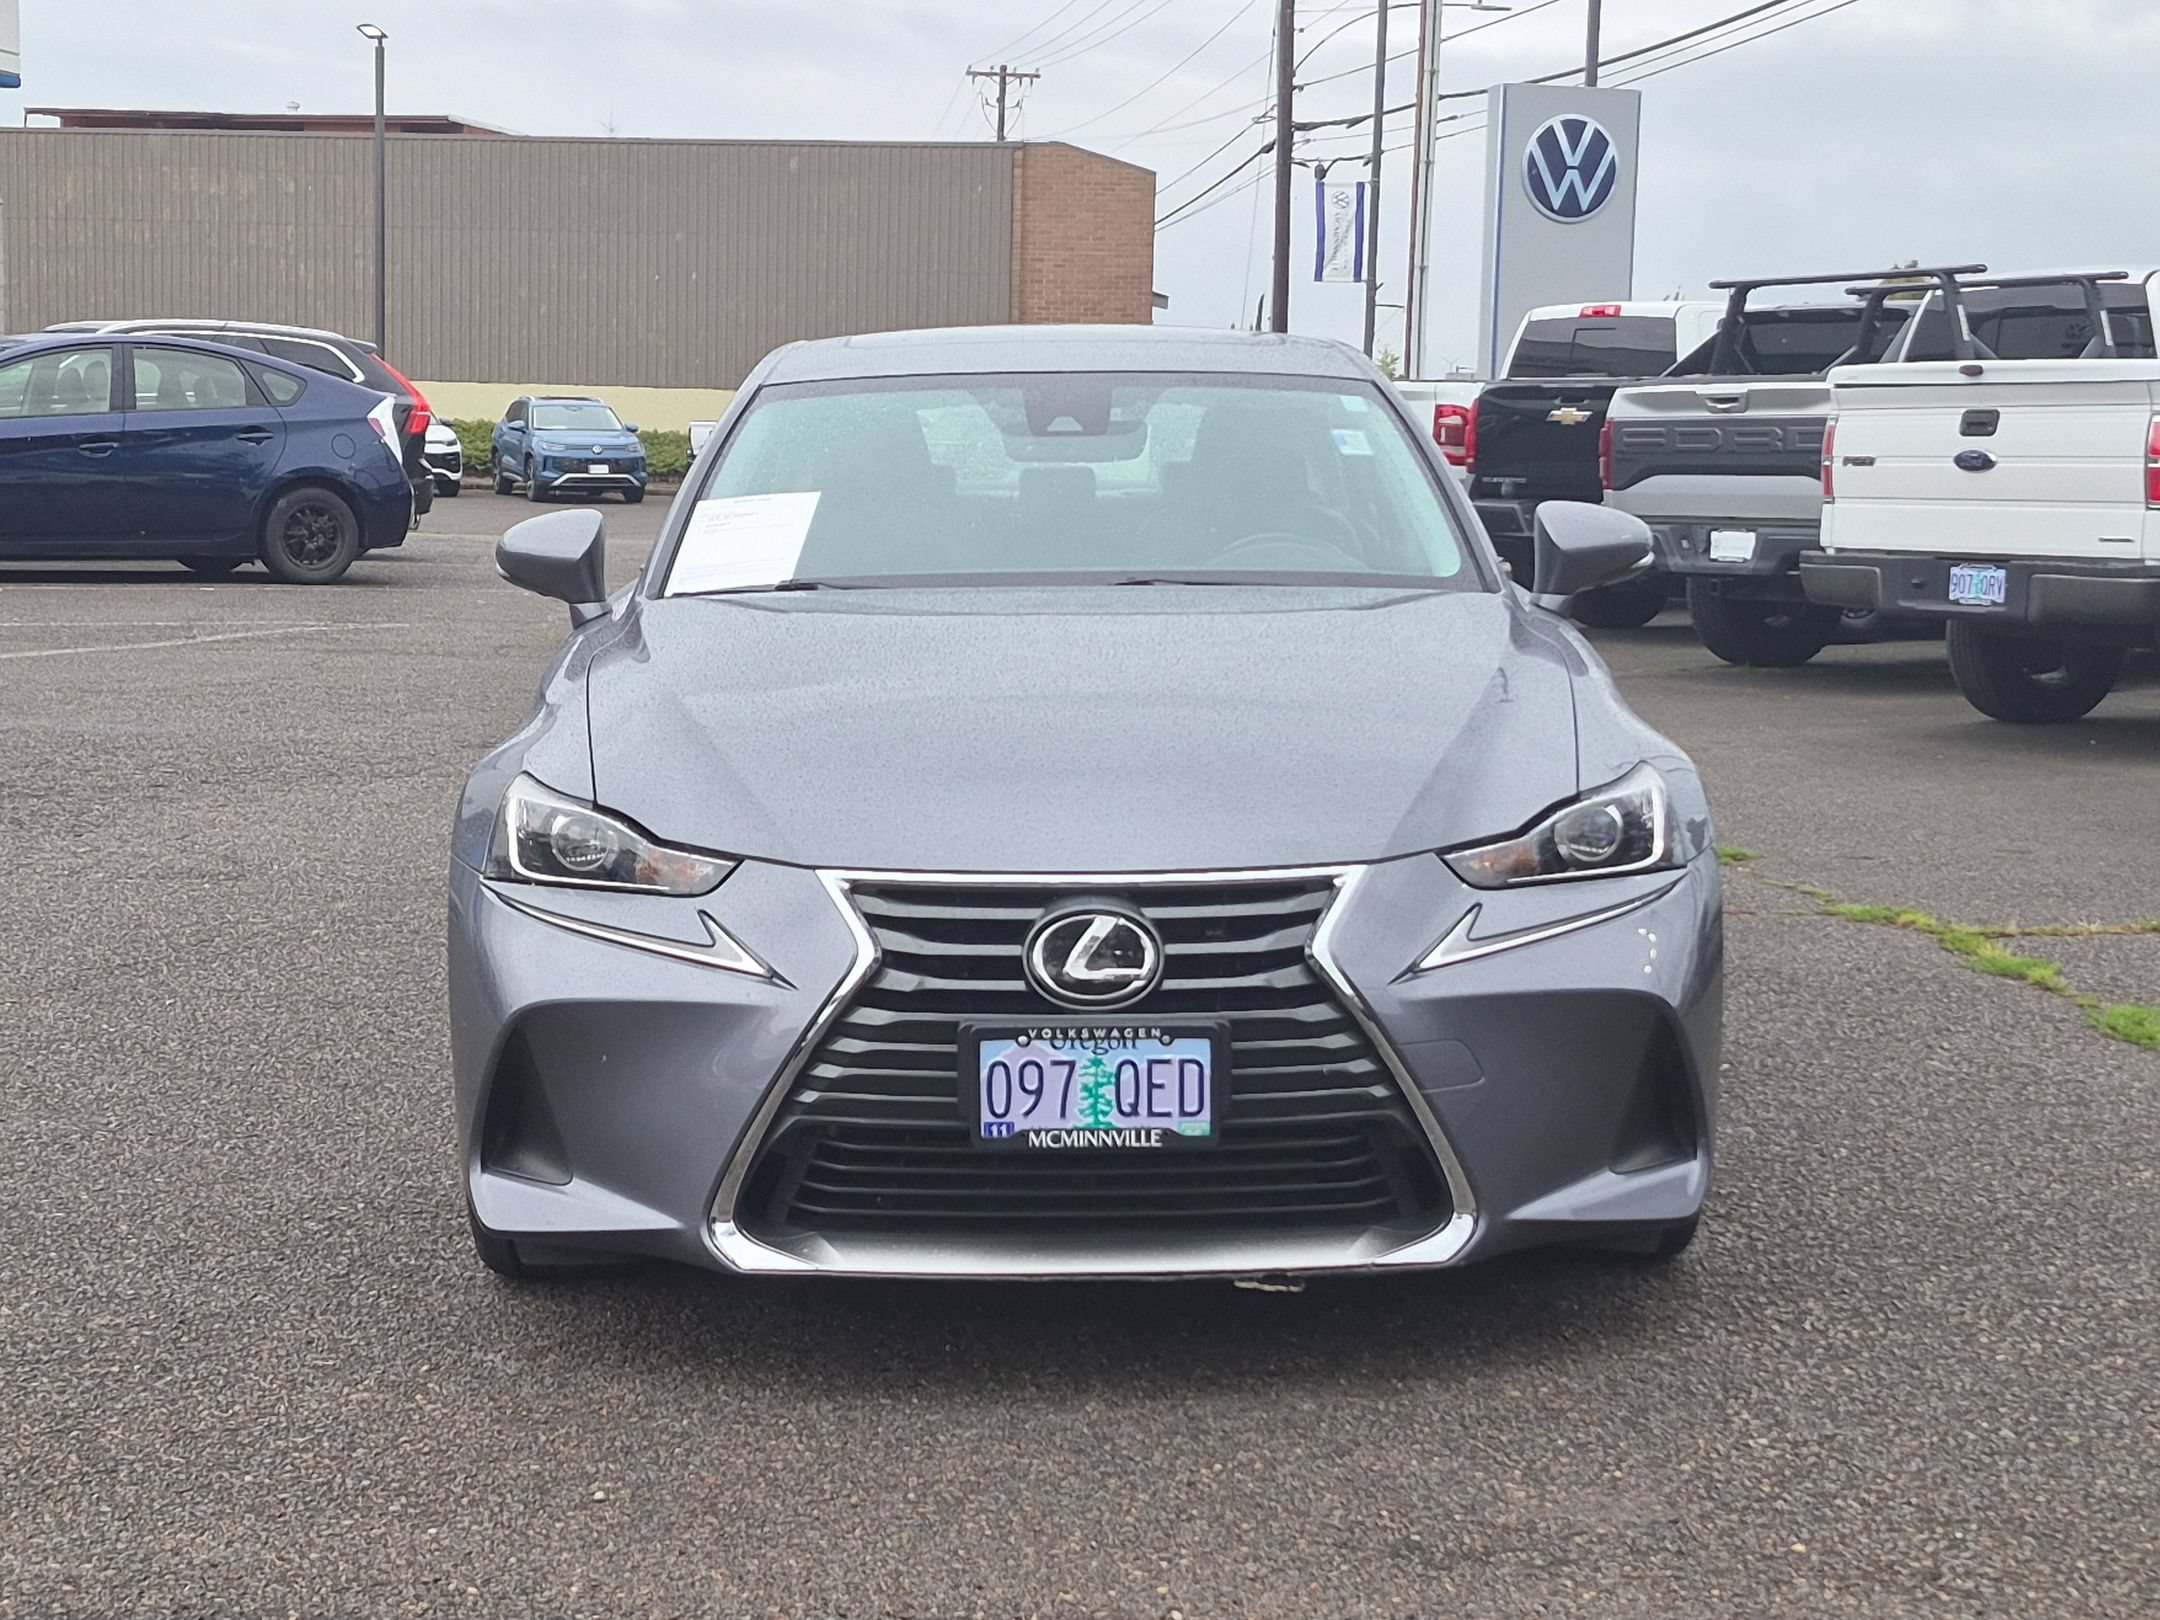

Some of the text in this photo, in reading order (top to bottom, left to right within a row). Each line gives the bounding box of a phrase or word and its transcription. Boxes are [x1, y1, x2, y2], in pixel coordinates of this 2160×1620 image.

[1526, 116, 1617, 221] VW
[1027, 1027, 1162, 1040] VOLKSWAGEN
[985, 1058, 1205, 1120] 097 QED
[1028, 1128, 1163, 1149] MCMINNVILLE
